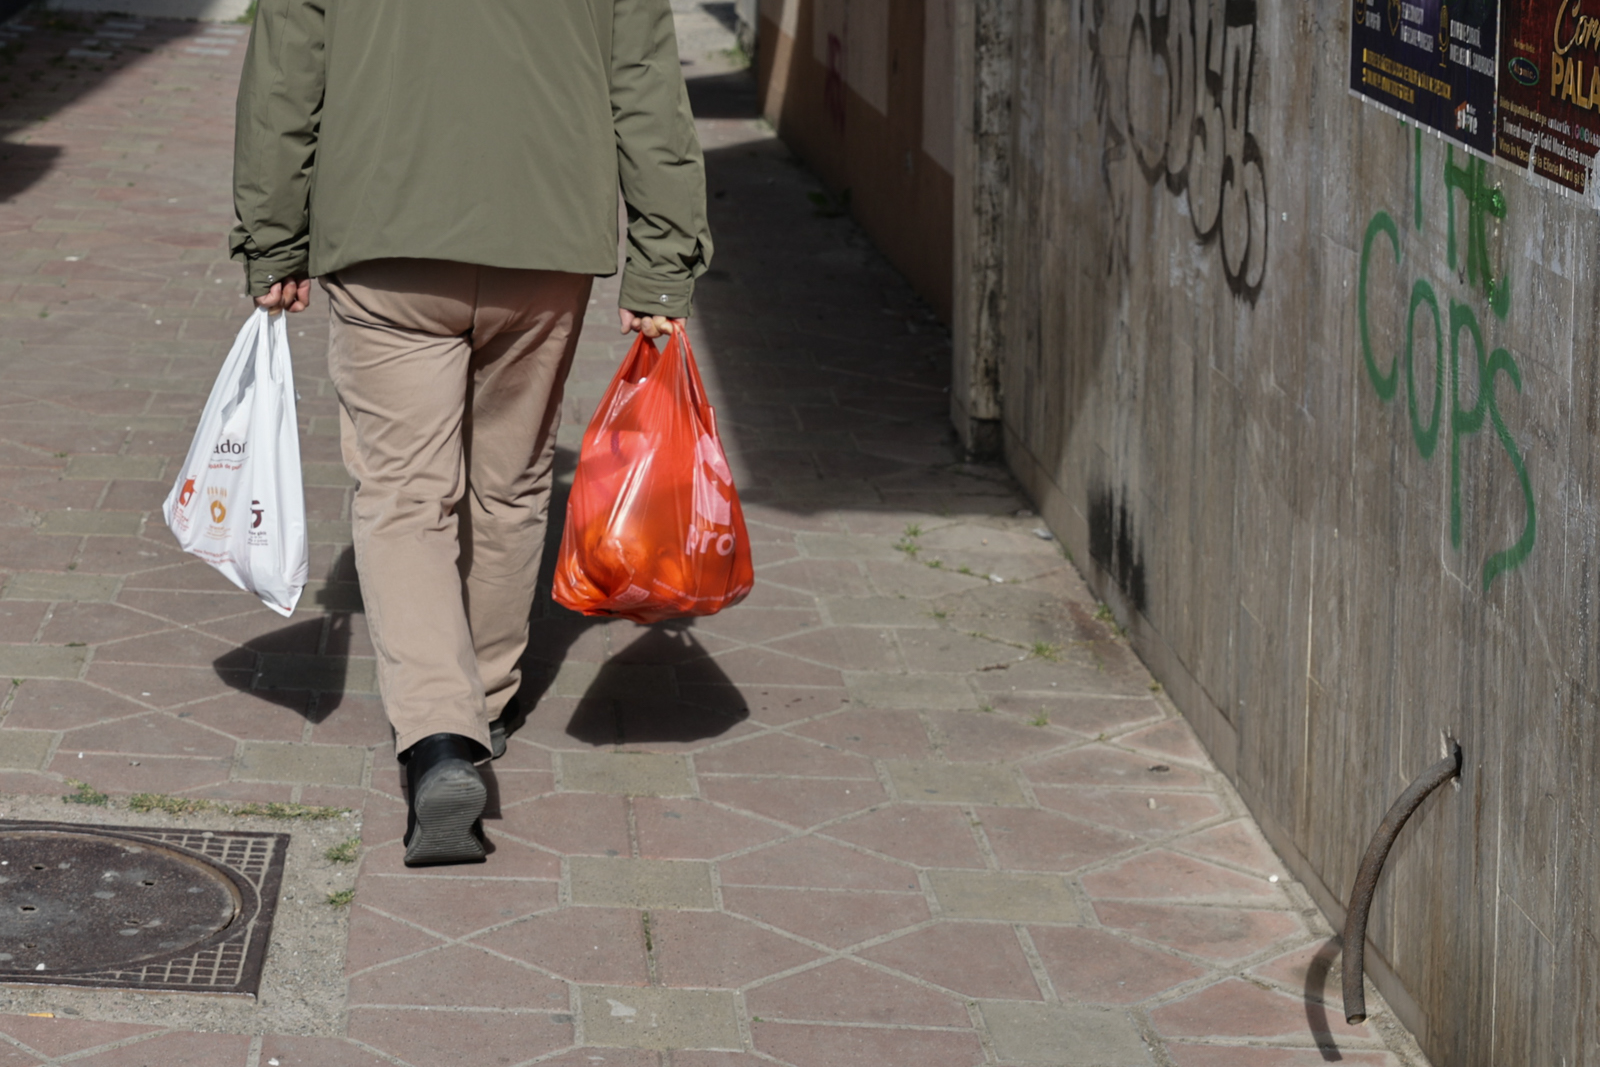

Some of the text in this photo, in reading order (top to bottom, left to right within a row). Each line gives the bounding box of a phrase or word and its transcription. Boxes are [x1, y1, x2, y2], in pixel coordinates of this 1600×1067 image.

[1540, 131, 1552, 151] Gold
[1566, 146, 1578, 163] este
[1357, 209, 1536, 594] COPS
